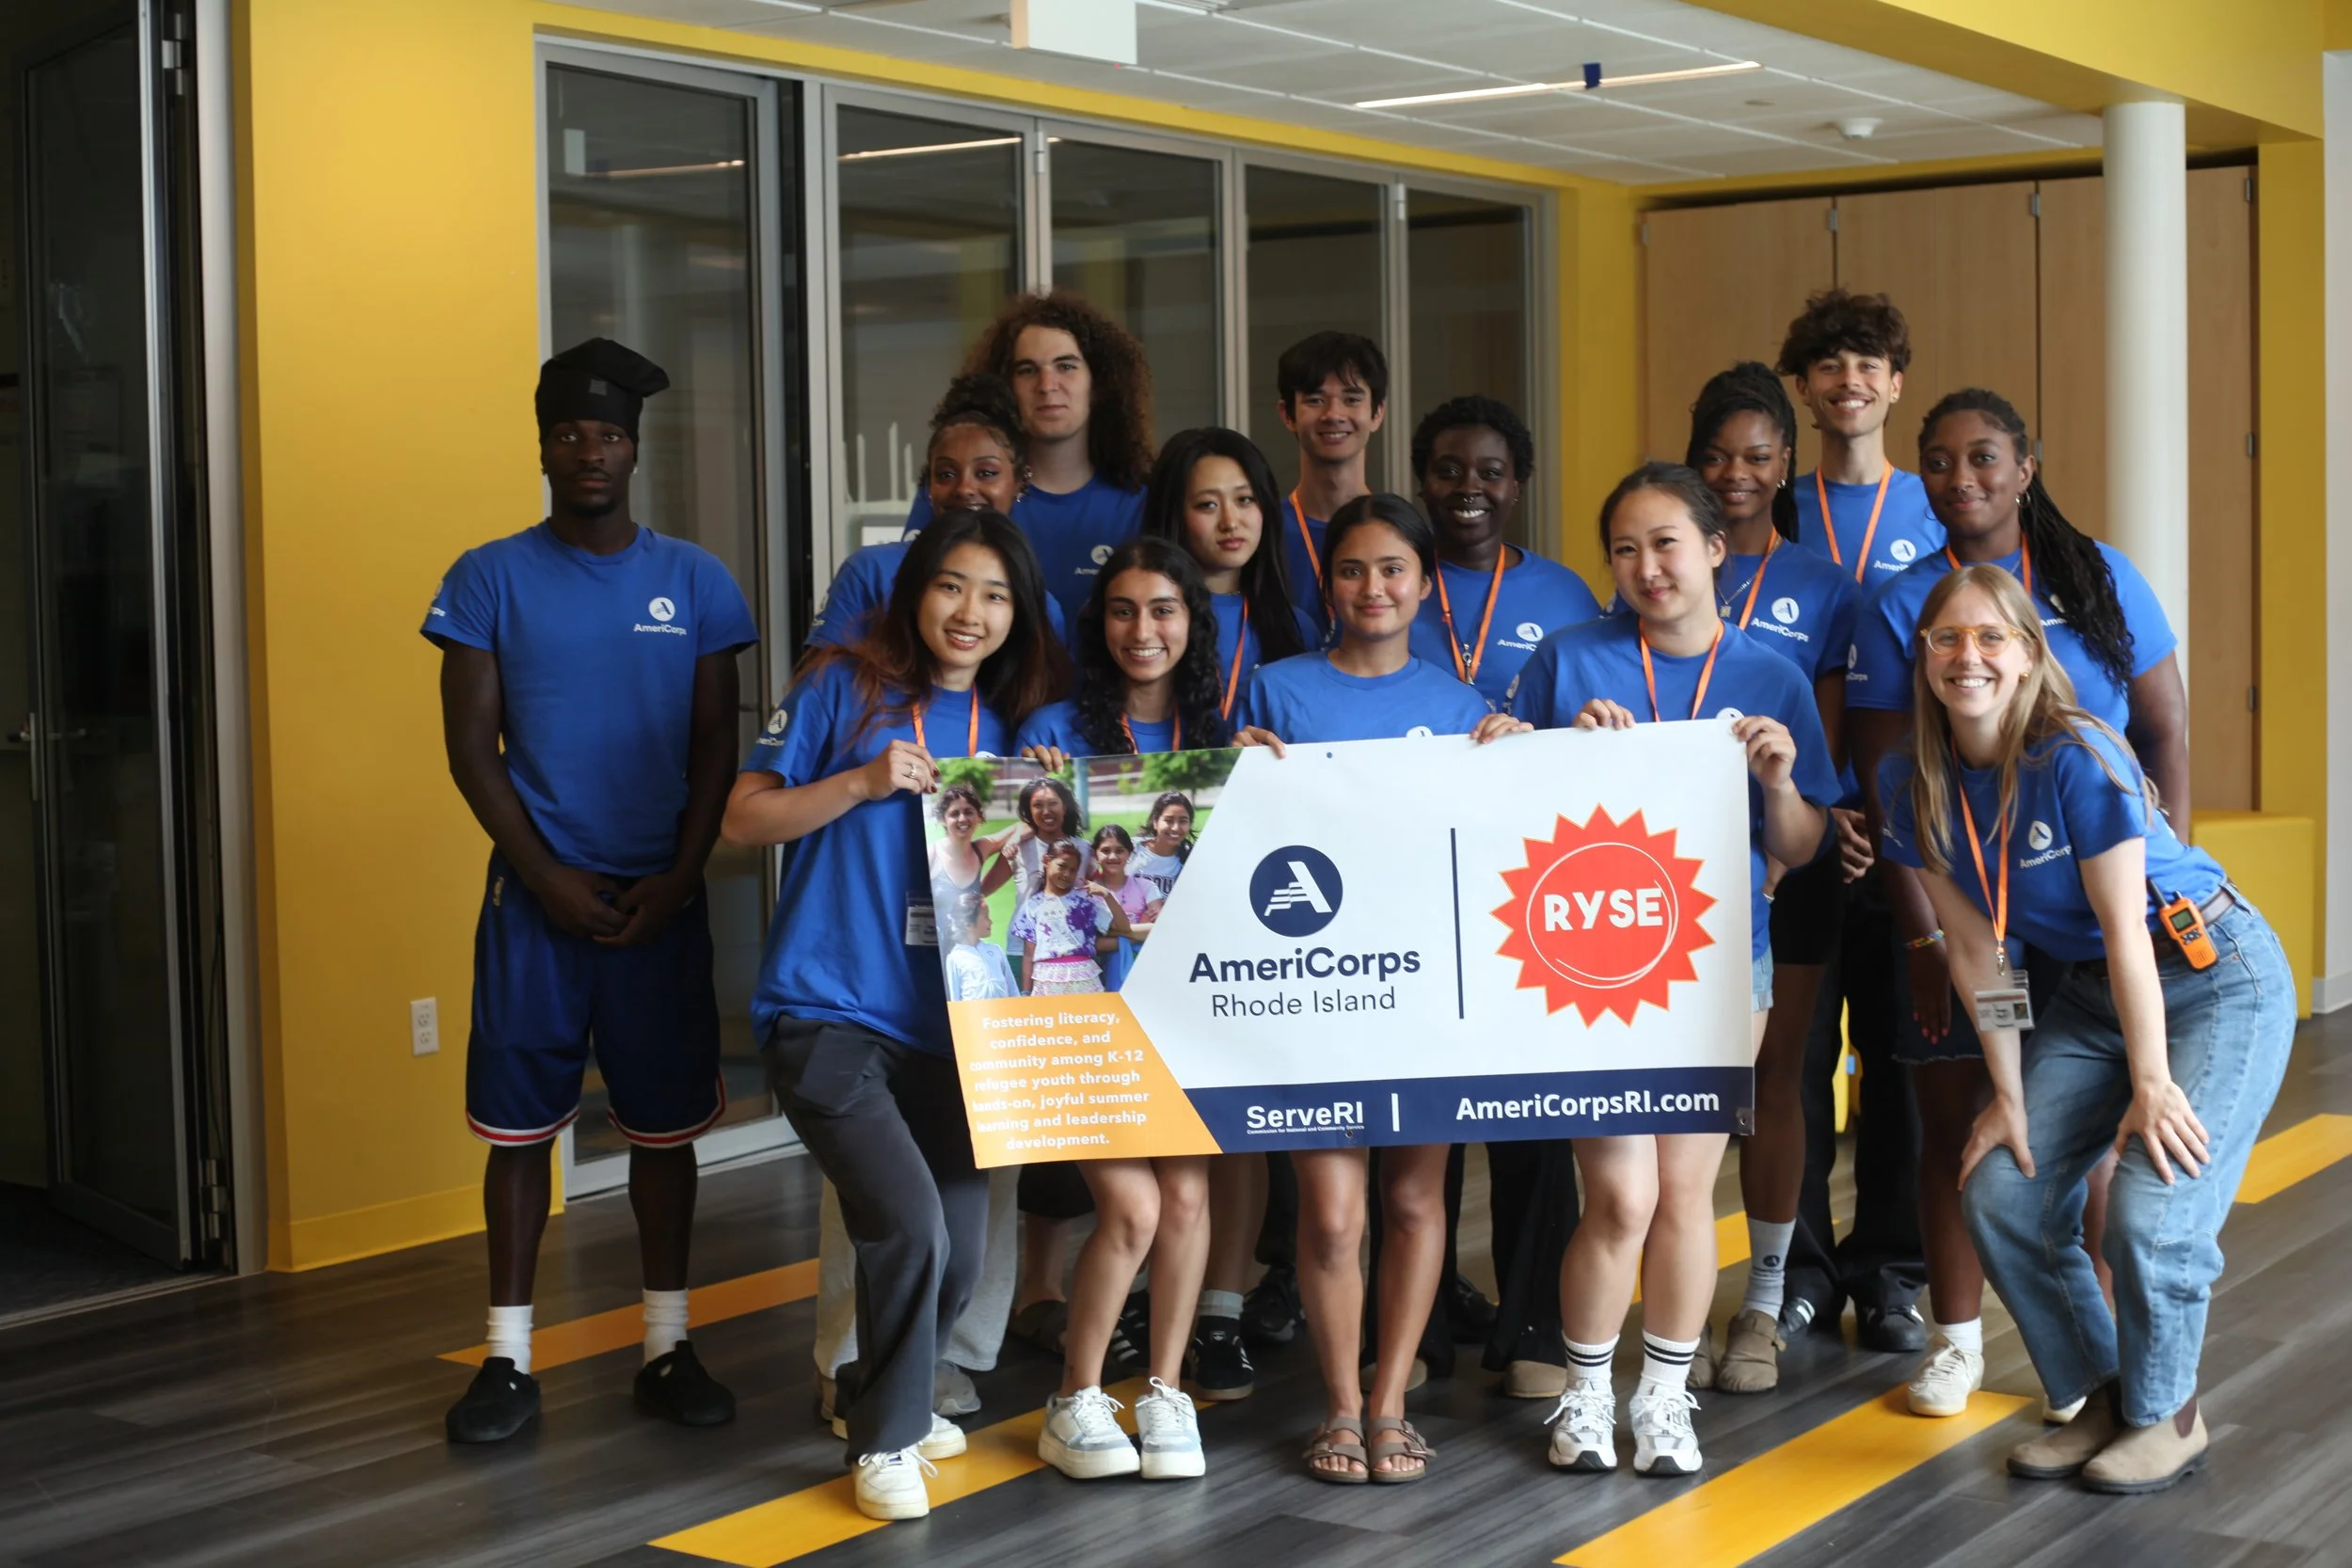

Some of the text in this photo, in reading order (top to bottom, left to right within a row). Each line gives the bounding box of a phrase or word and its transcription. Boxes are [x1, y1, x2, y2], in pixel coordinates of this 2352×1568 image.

[1751, 617, 1809, 642] AmeriCorps
[1497, 639, 1537, 652] AmeriC
[2019, 843, 2073, 869] AmeriCorp
[1544, 888, 1663, 932] RYSE
[1189, 946, 1422, 983] AmeriCorps
[1212, 985, 1396, 1018] Rhode Island
[982, 1011, 1120, 1030] Fostering literacy,
[990, 1031, 1111, 1050] confidence, and
[969, 1050, 1144, 1072] community among K-12
[974, 1070, 1141, 1093] refugee youth through
[1040, 1092, 1085, 1110] joyful
[1089, 1091, 1150, 1104] summer
[1455, 1090, 1720, 1122] AmeriCorpsRI.com
[1033, 1113, 1062, 1127] and
[1066, 1110, 1147, 1126] leadership
[1246, 1101, 1364, 1129] ServeRI
[1005, 1132, 1111, 1150] development.
